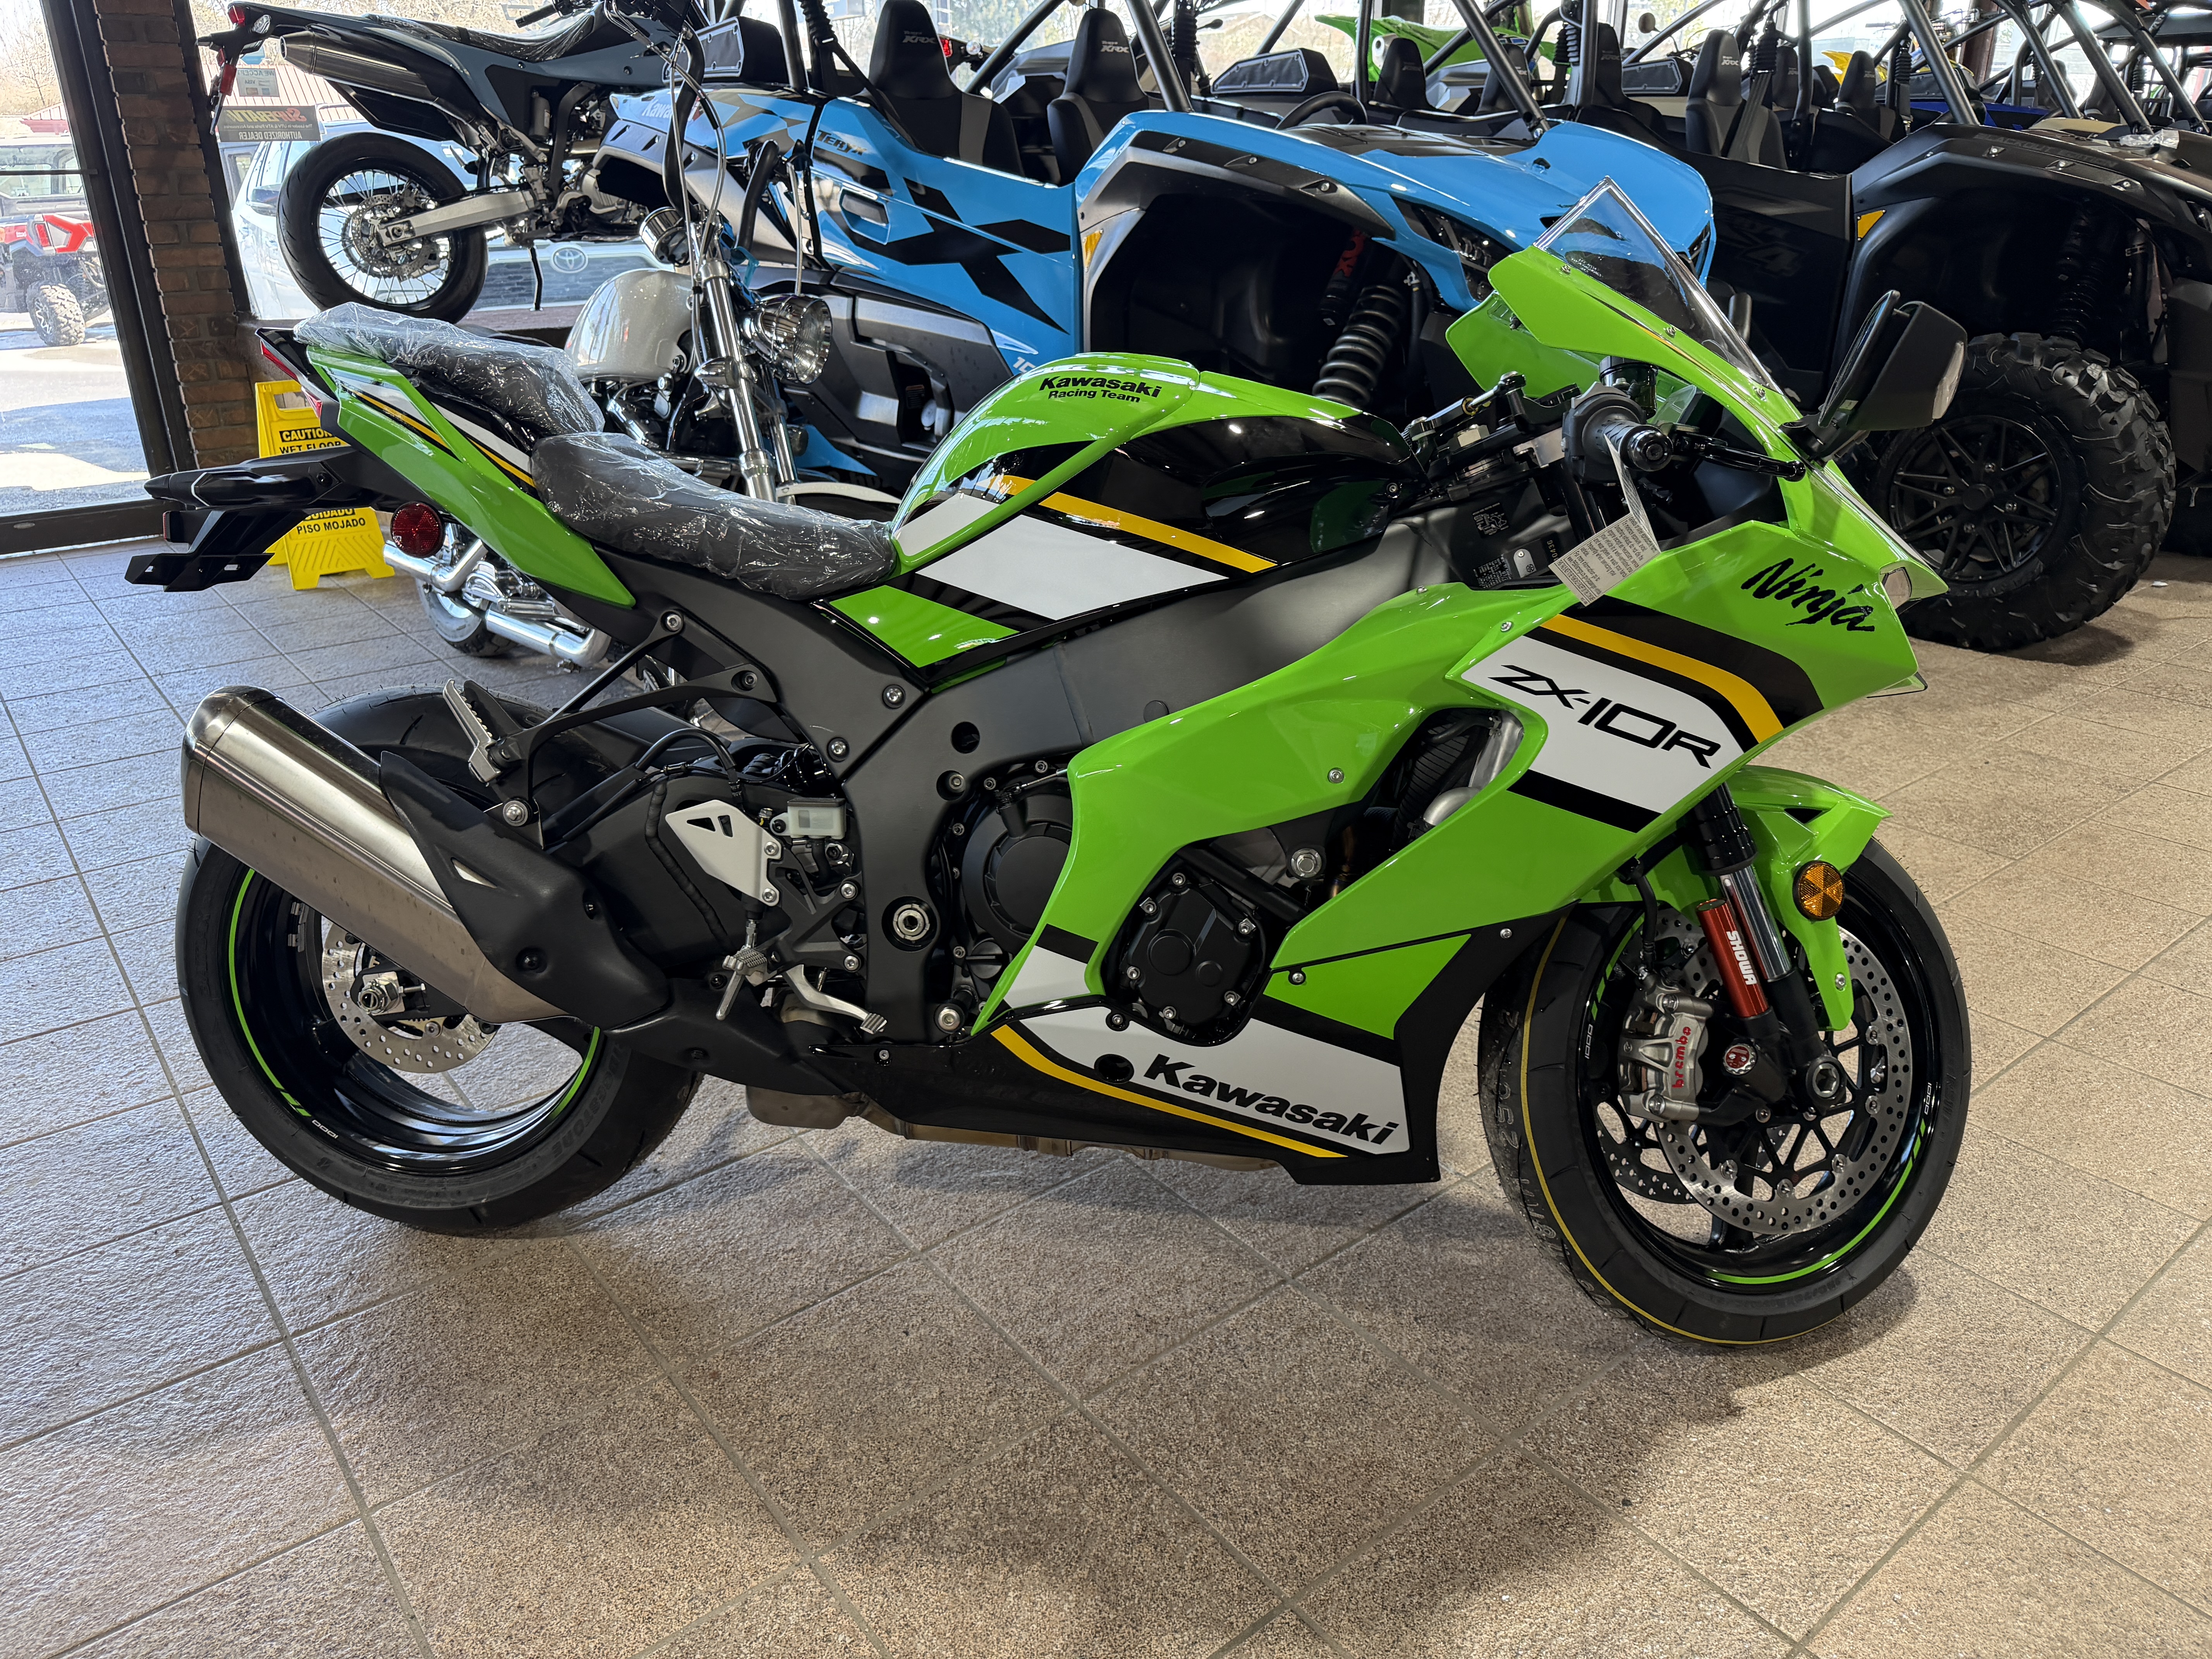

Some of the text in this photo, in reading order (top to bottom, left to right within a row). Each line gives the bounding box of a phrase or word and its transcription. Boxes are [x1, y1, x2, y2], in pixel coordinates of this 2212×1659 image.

[1101, 45, 1130, 53] KRX
[642, 99, 673, 118] Kawa
[817, 130, 867, 156] TERYX
[1973, 133, 2118, 167] BLACKOUT EDITION
[1039, 376, 1162, 398] Kawasaki
[1048, 388, 1140, 403] Racing Team
[297, 518, 366, 535] PISO MOJADO
[1741, 558, 1875, 633] Ninja
[1488, 664, 1722, 769] ZX-10R
[1726, 931, 1757, 986] SHOWA
[1585, 1024, 1593, 1060] 1000
[1671, 1025, 1692, 1089] brembo
[1144, 1054, 1399, 1145] Kawasaki
[312, 1120, 338, 1139] 1000
